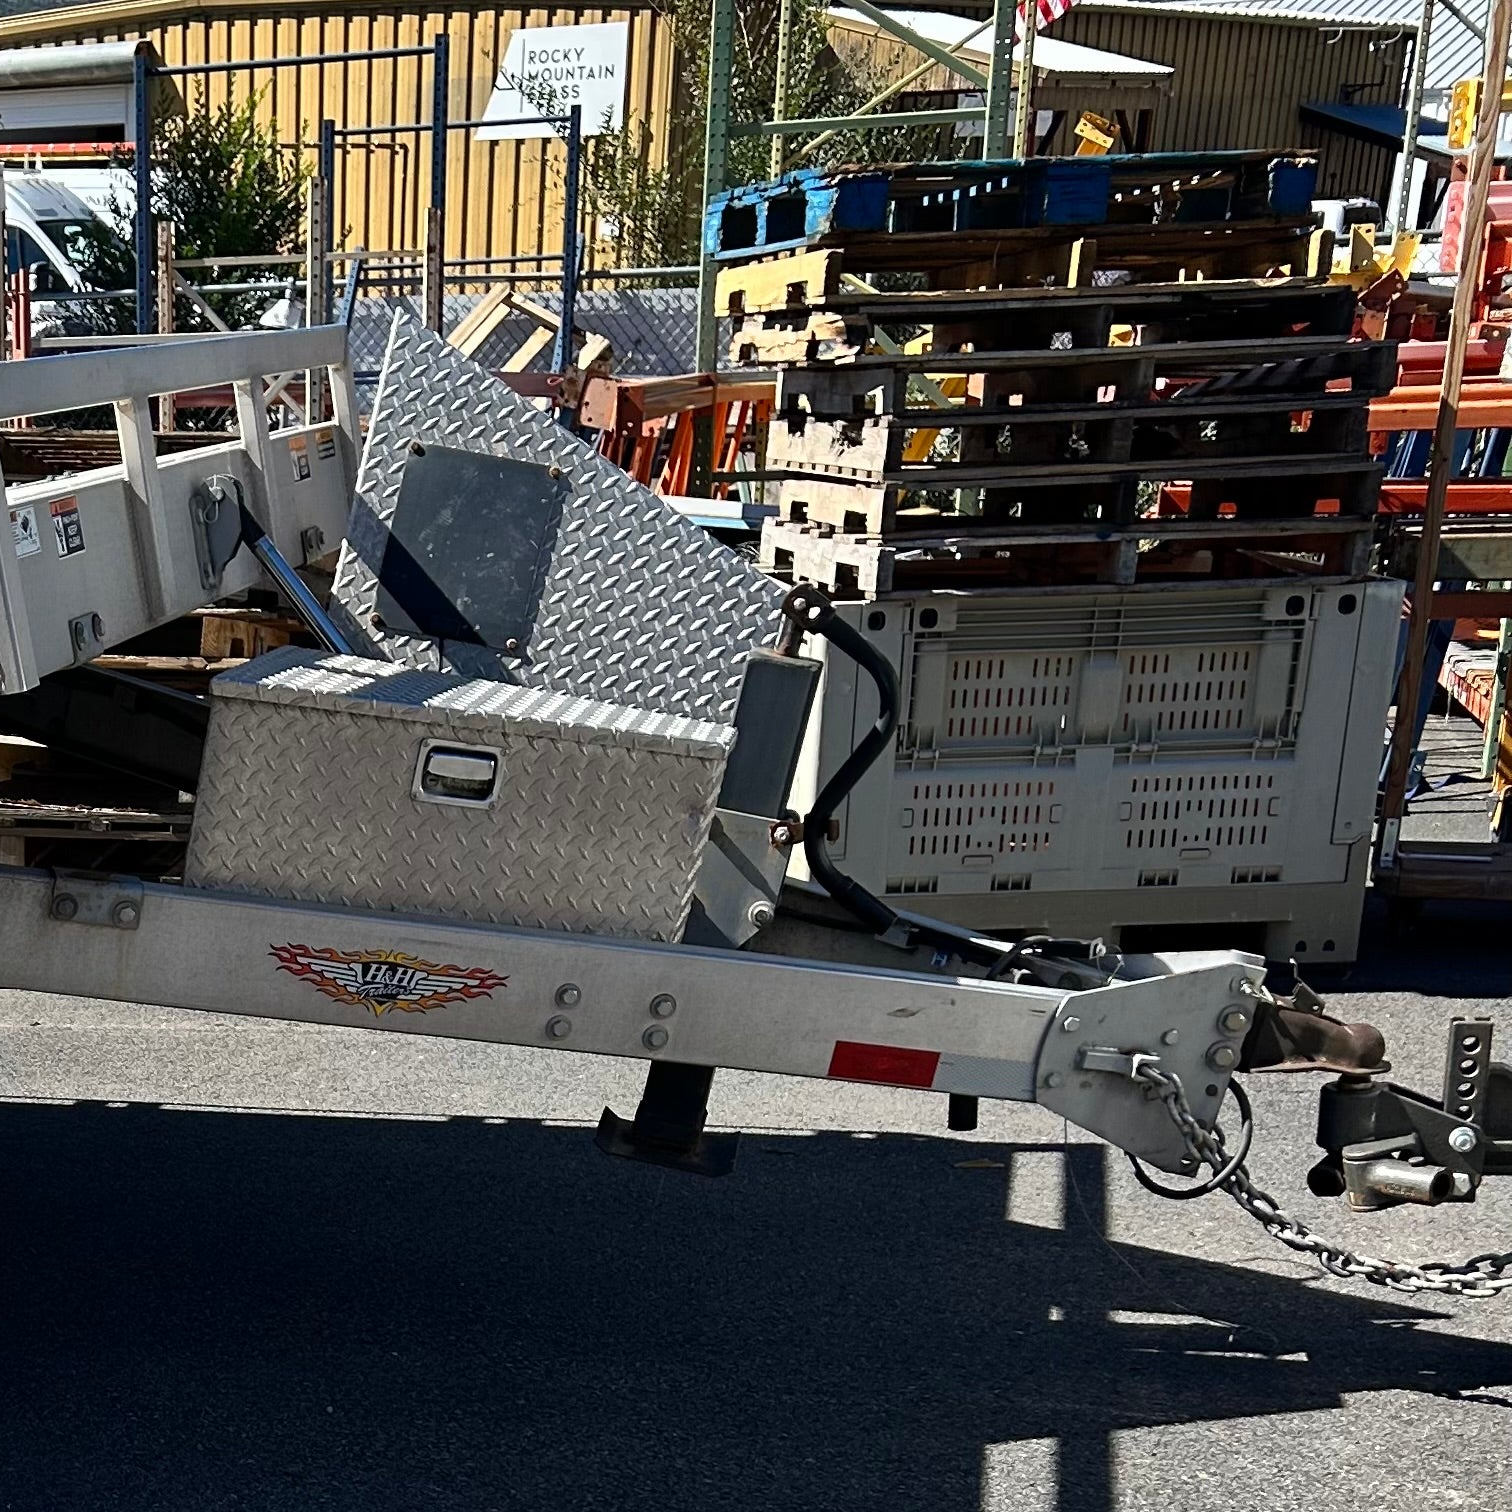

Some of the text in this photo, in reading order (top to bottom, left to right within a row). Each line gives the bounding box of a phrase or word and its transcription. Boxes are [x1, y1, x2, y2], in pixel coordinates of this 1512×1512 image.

[528, 47, 585, 64] ROCKY
[527, 63, 615, 81] MOUNTAIN
[364, 963, 416, 986] H&H
